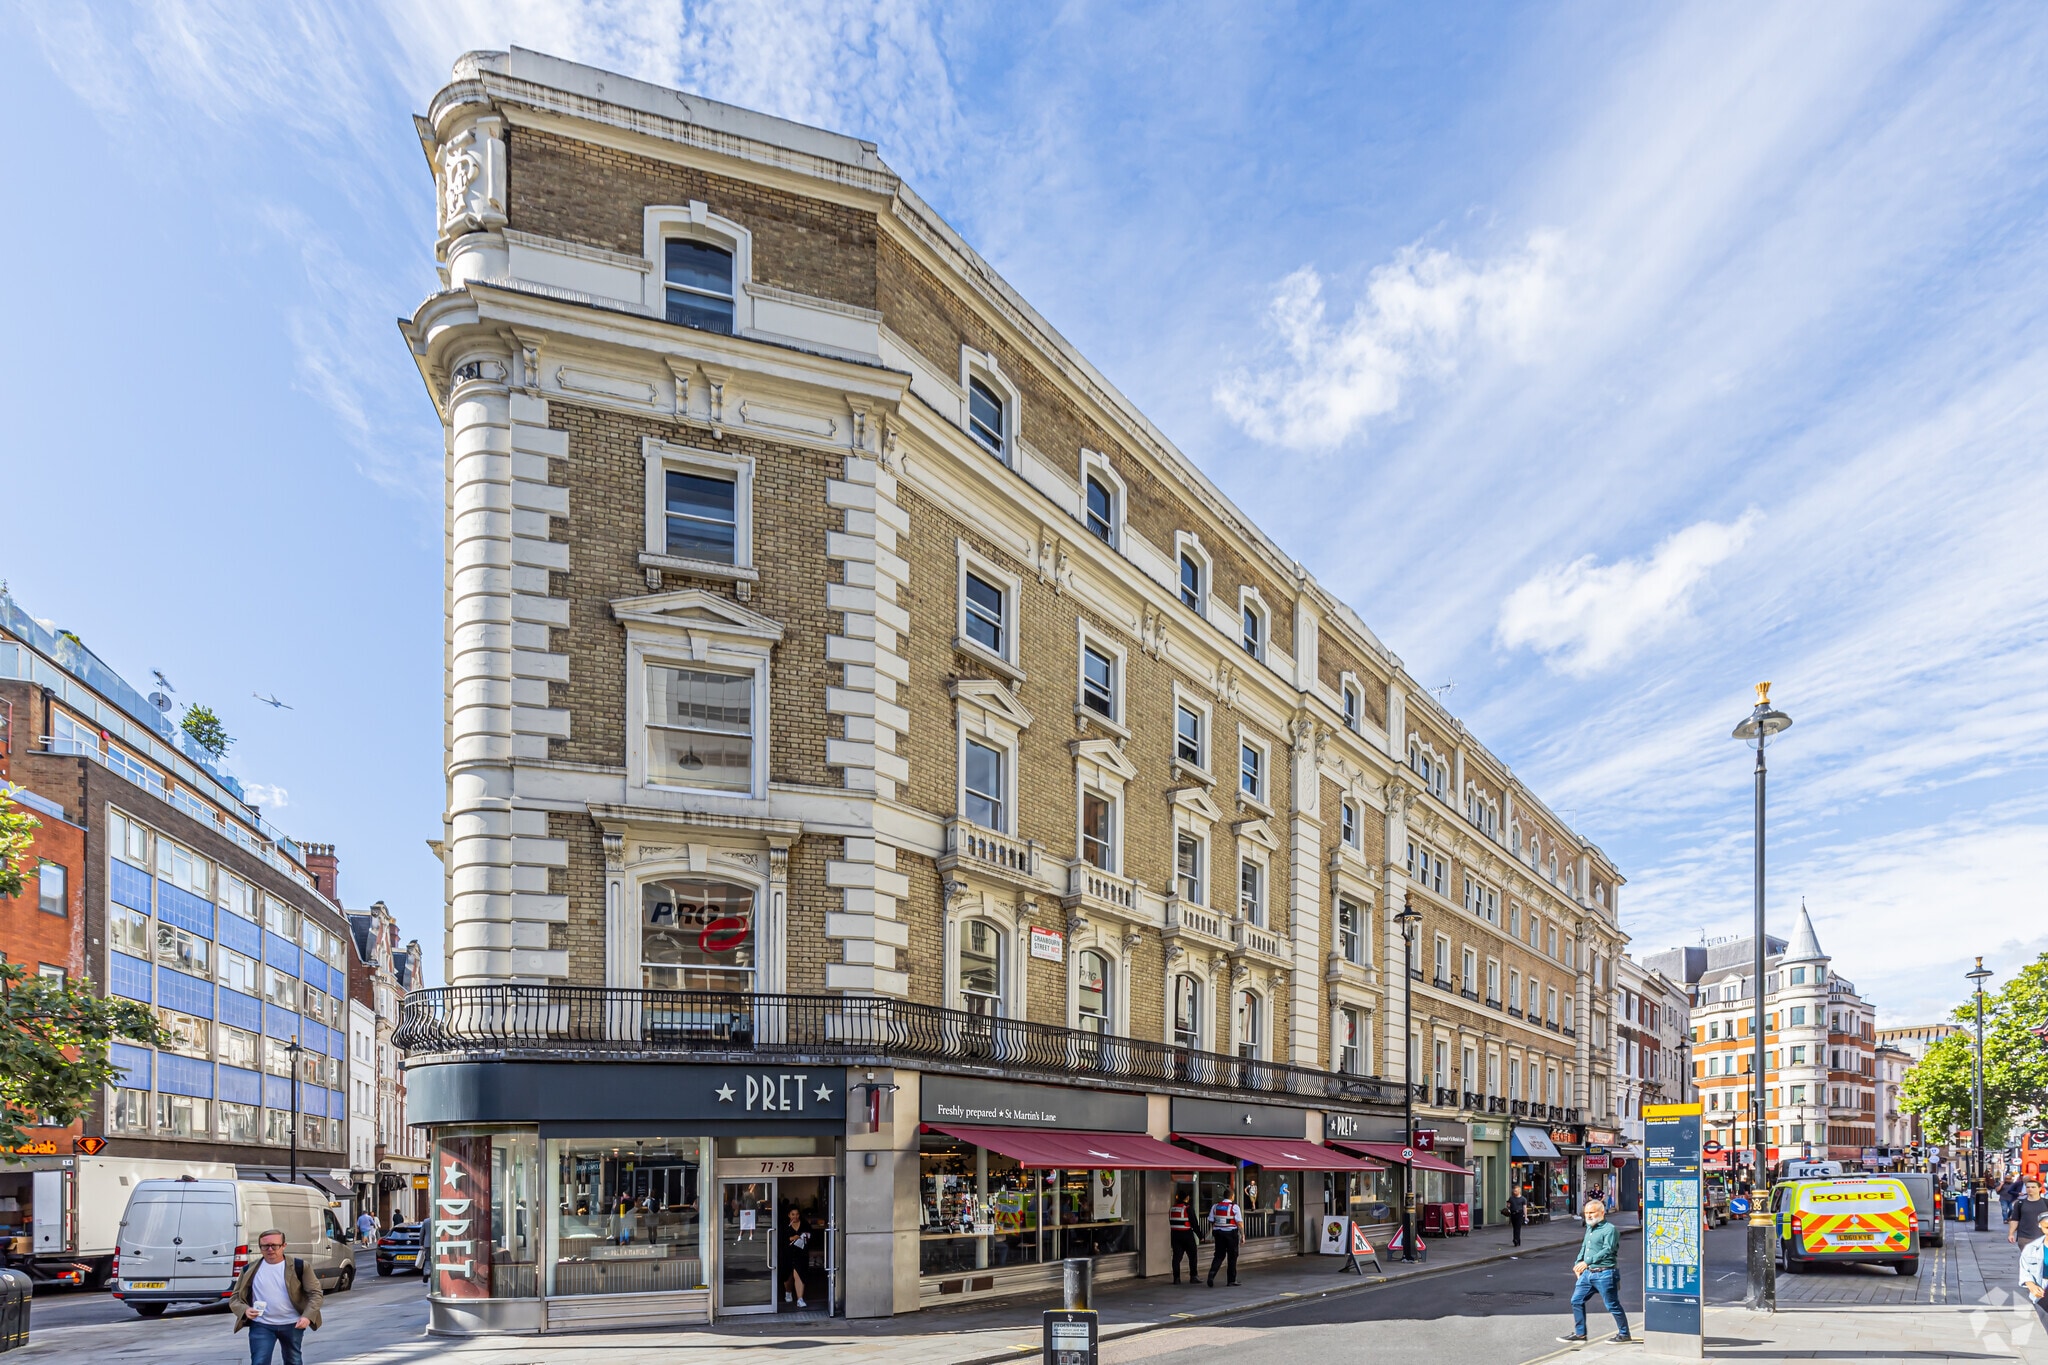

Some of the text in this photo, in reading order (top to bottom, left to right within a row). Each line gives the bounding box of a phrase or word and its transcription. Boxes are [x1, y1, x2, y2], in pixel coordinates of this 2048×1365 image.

[651, 902, 720, 925] PRG
[1034, 935, 1060, 946] CRANBOURN
[1034, 943, 1050, 951] STREET
[745, 1074, 808, 1111] PRET
[937, 1104, 1057, 1121] Freshly prepared St Martin's Lane
[1337, 1115, 1353, 1136] PRET
[15, 1139, 57, 1154] ebab
[1799, 1168, 1830, 1177] KCS
[1812, 1192, 1894, 1202] POLICE
[435, 1198, 474, 1278] PRET
